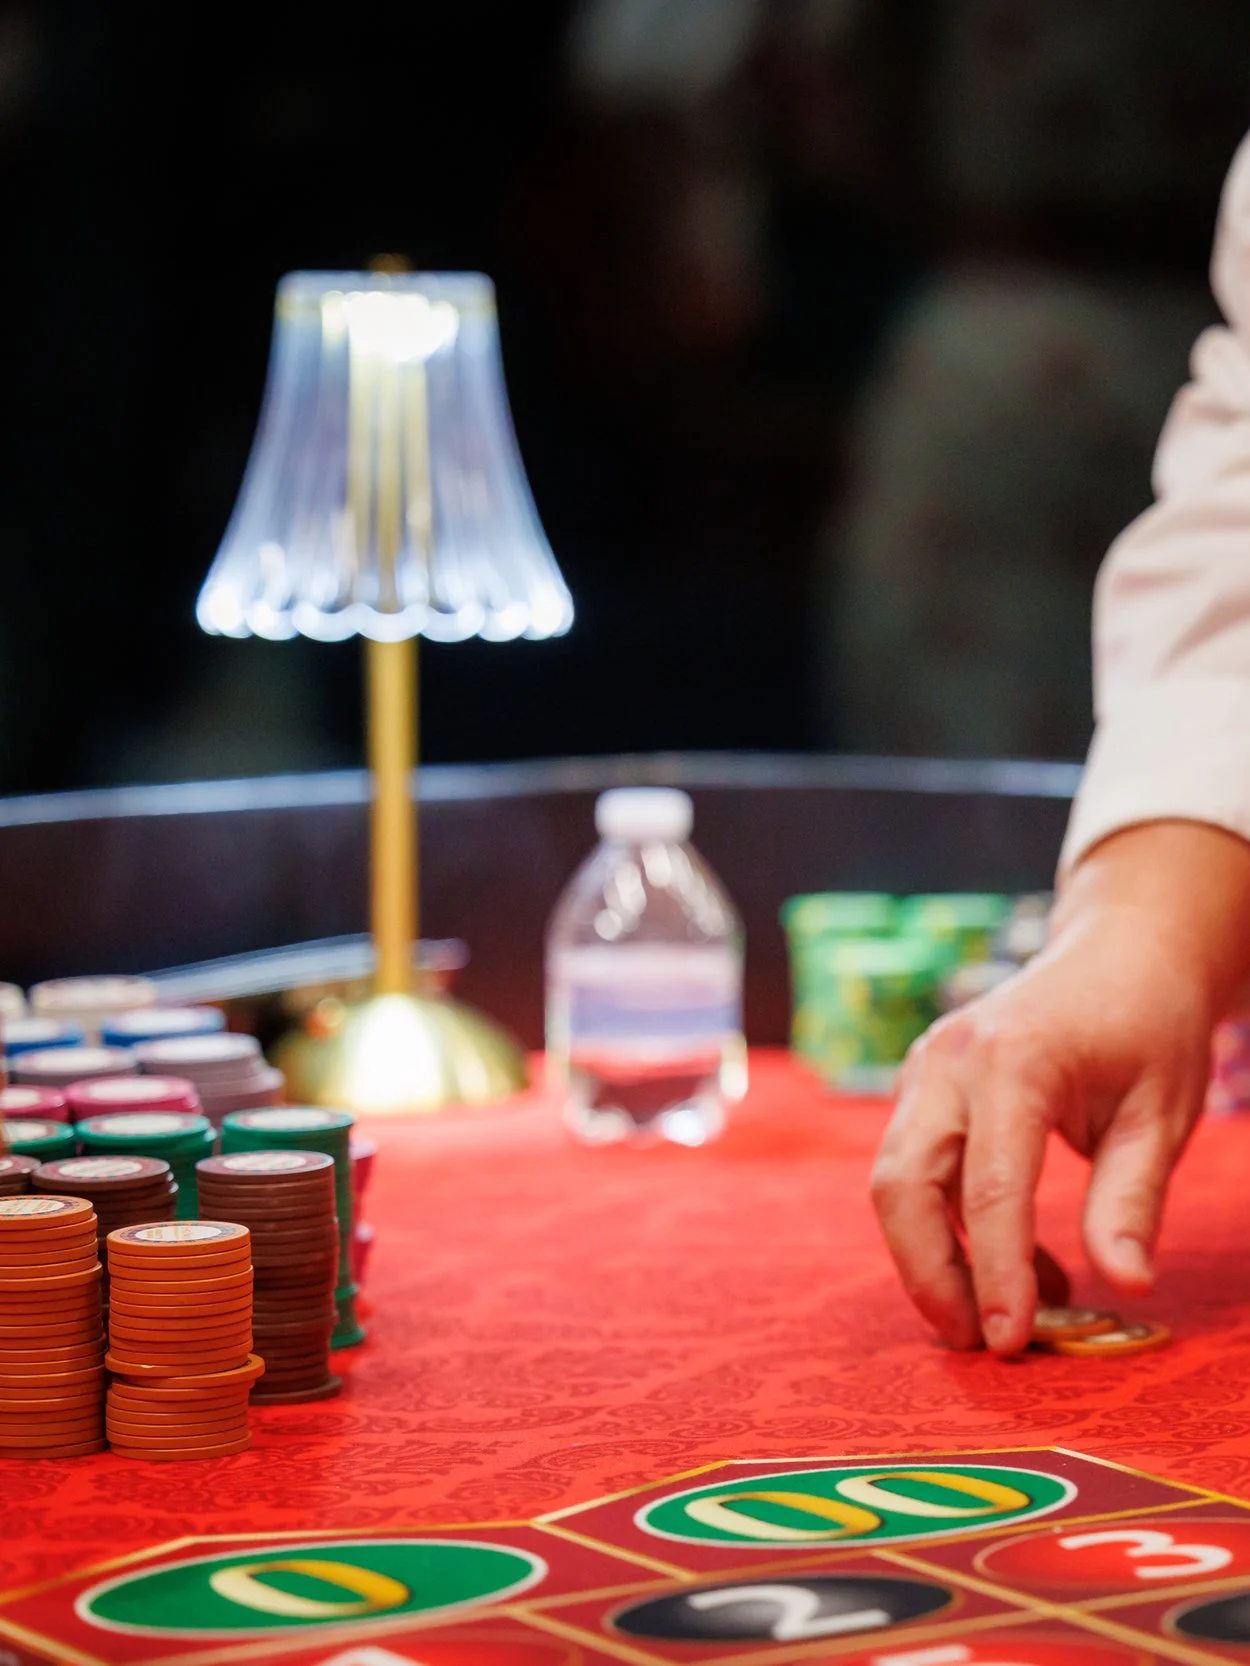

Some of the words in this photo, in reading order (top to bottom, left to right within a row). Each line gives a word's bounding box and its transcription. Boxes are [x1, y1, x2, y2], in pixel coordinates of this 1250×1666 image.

[684, 1471, 1033, 1541] 00
[1058, 1530, 1233, 1578] 3
[208, 1559, 412, 1619] 0
[687, 1585, 891, 1641] 2
